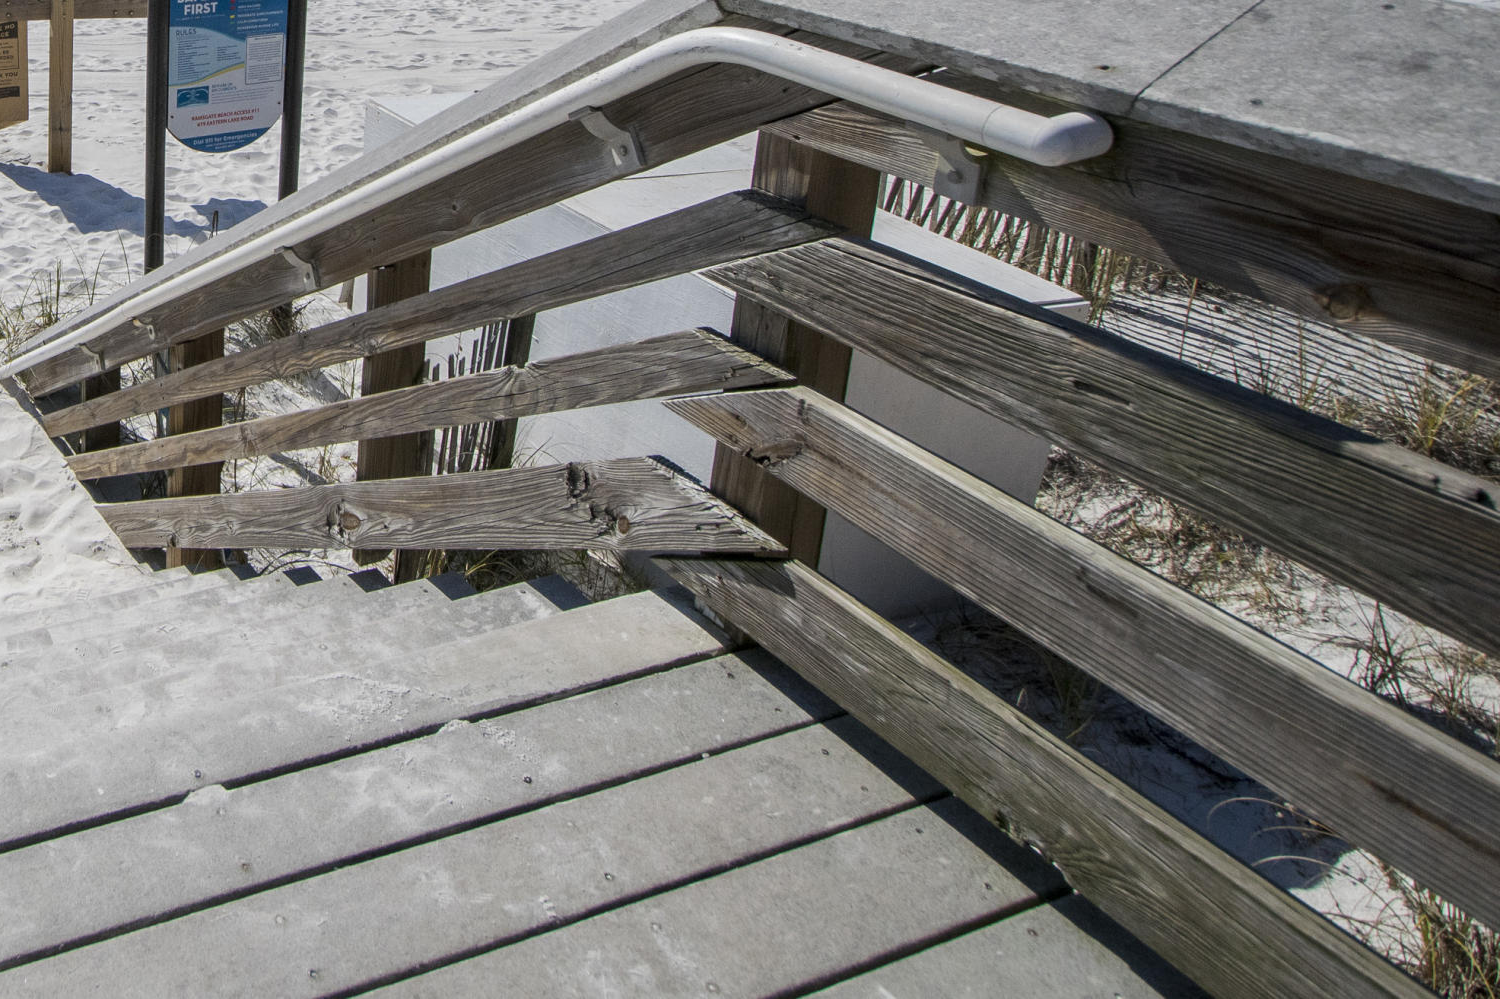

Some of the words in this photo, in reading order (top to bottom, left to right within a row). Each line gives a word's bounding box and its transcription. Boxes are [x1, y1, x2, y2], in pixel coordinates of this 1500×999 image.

[184, 2, 218, 15] FIRST
[176, 28, 197, 36] RULES
[4, 71, 18, 79] YOU
